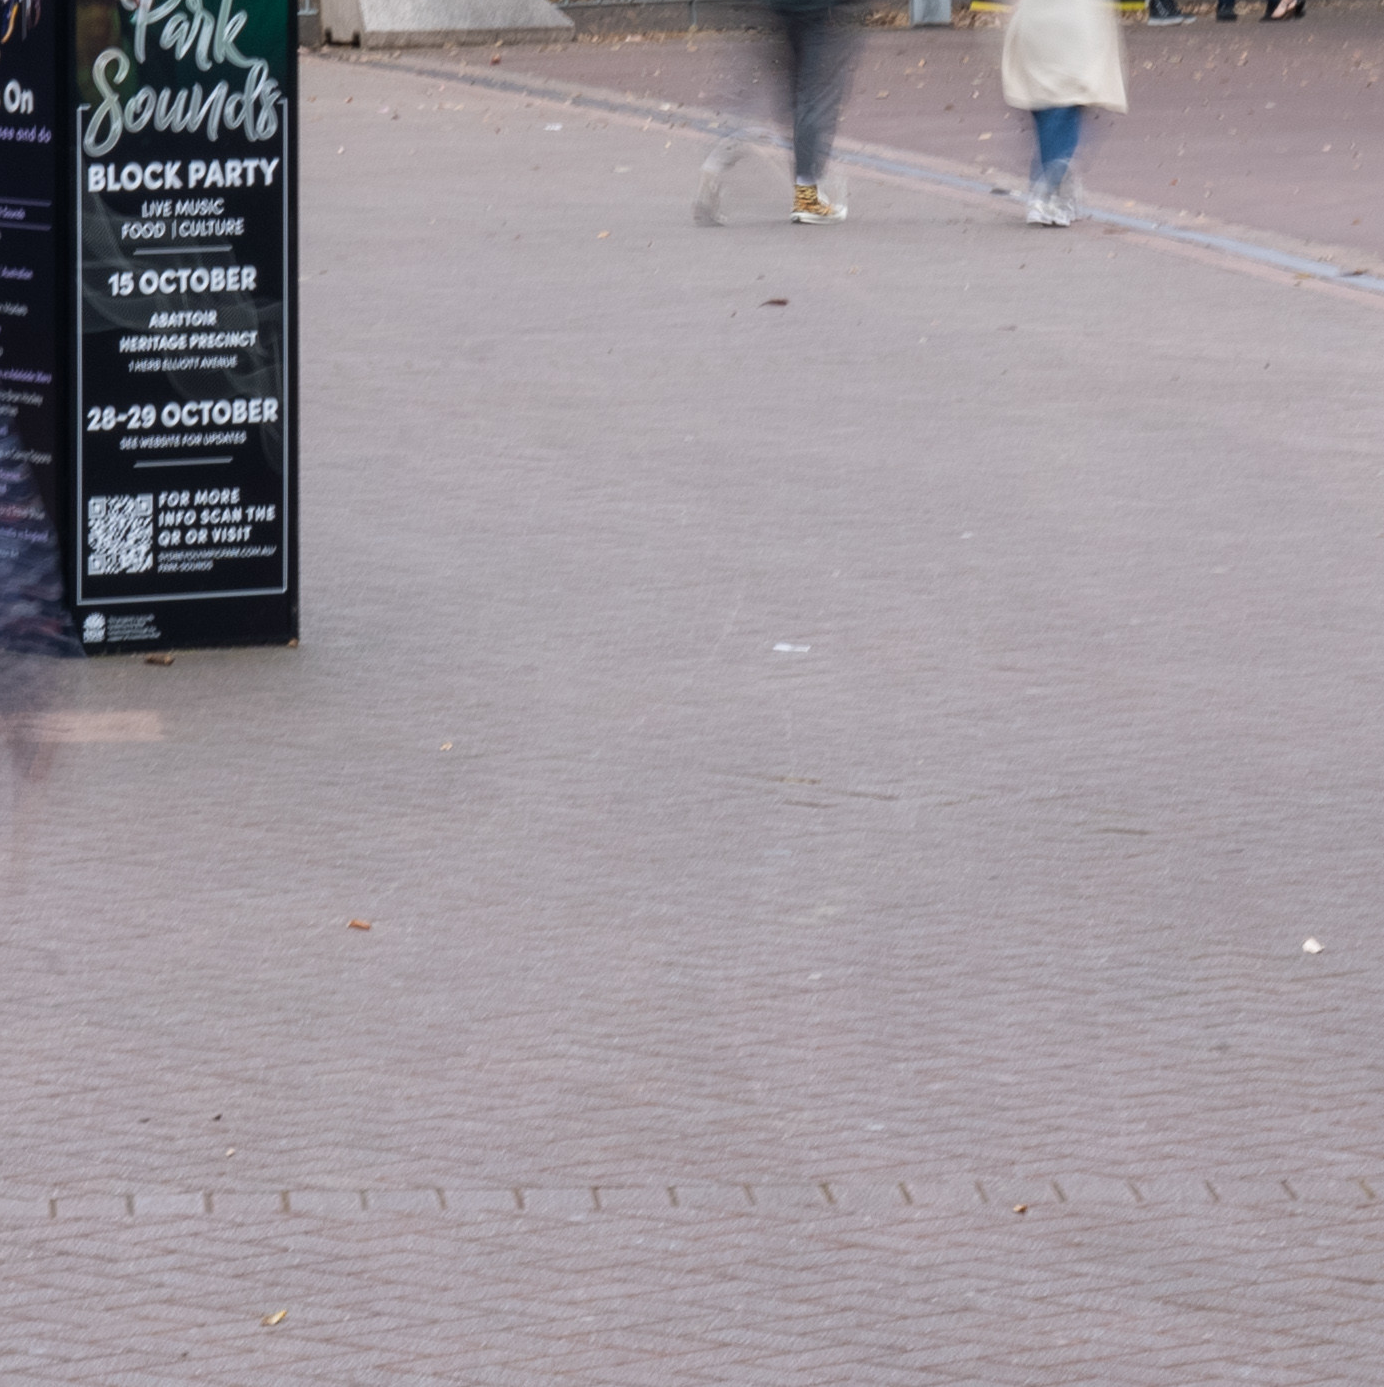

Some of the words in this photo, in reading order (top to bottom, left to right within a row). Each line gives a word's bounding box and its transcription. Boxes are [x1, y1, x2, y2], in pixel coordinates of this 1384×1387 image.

[3, 79, 34, 115] On
[83, 47, 282, 158] Sounds
[16, 125, 36, 142] and
[37, 126, 52, 143] do
[88, 161, 183, 192] BLOCK
[188, 157, 280, 189] PARTY
[141, 199, 172, 218] LIVE
[174, 197, 225, 216] MUSIC
[121, 220, 165, 240] FOOD
[178, 217, 245, 238] CULTURE
[107, 271, 135, 297] 15
[138, 264, 258, 295] OCTOBER
[148, 309, 217, 329] ABATTOIR
[119, 333, 188, 354] HERITAGE
[189, 330, 258, 350] PRECINCT
[87, 403, 157, 431] 28-29
[160, 397, 279, 427] OCTOBER
[120, 434, 138, 450] SEE
[181, 433, 202, 447] FOR
[203, 430, 247, 446] UPDATES
[158, 490, 191, 509] FOR
[193, 487, 241, 507] MORE
[158, 508, 197, 527] INFO
[199, 506, 243, 525] SCAN
[245, 504, 276, 523] THE
[158, 529, 182, 548] QR
[184, 527, 209, 545] OR
[211, 524, 253, 544] VISIT
